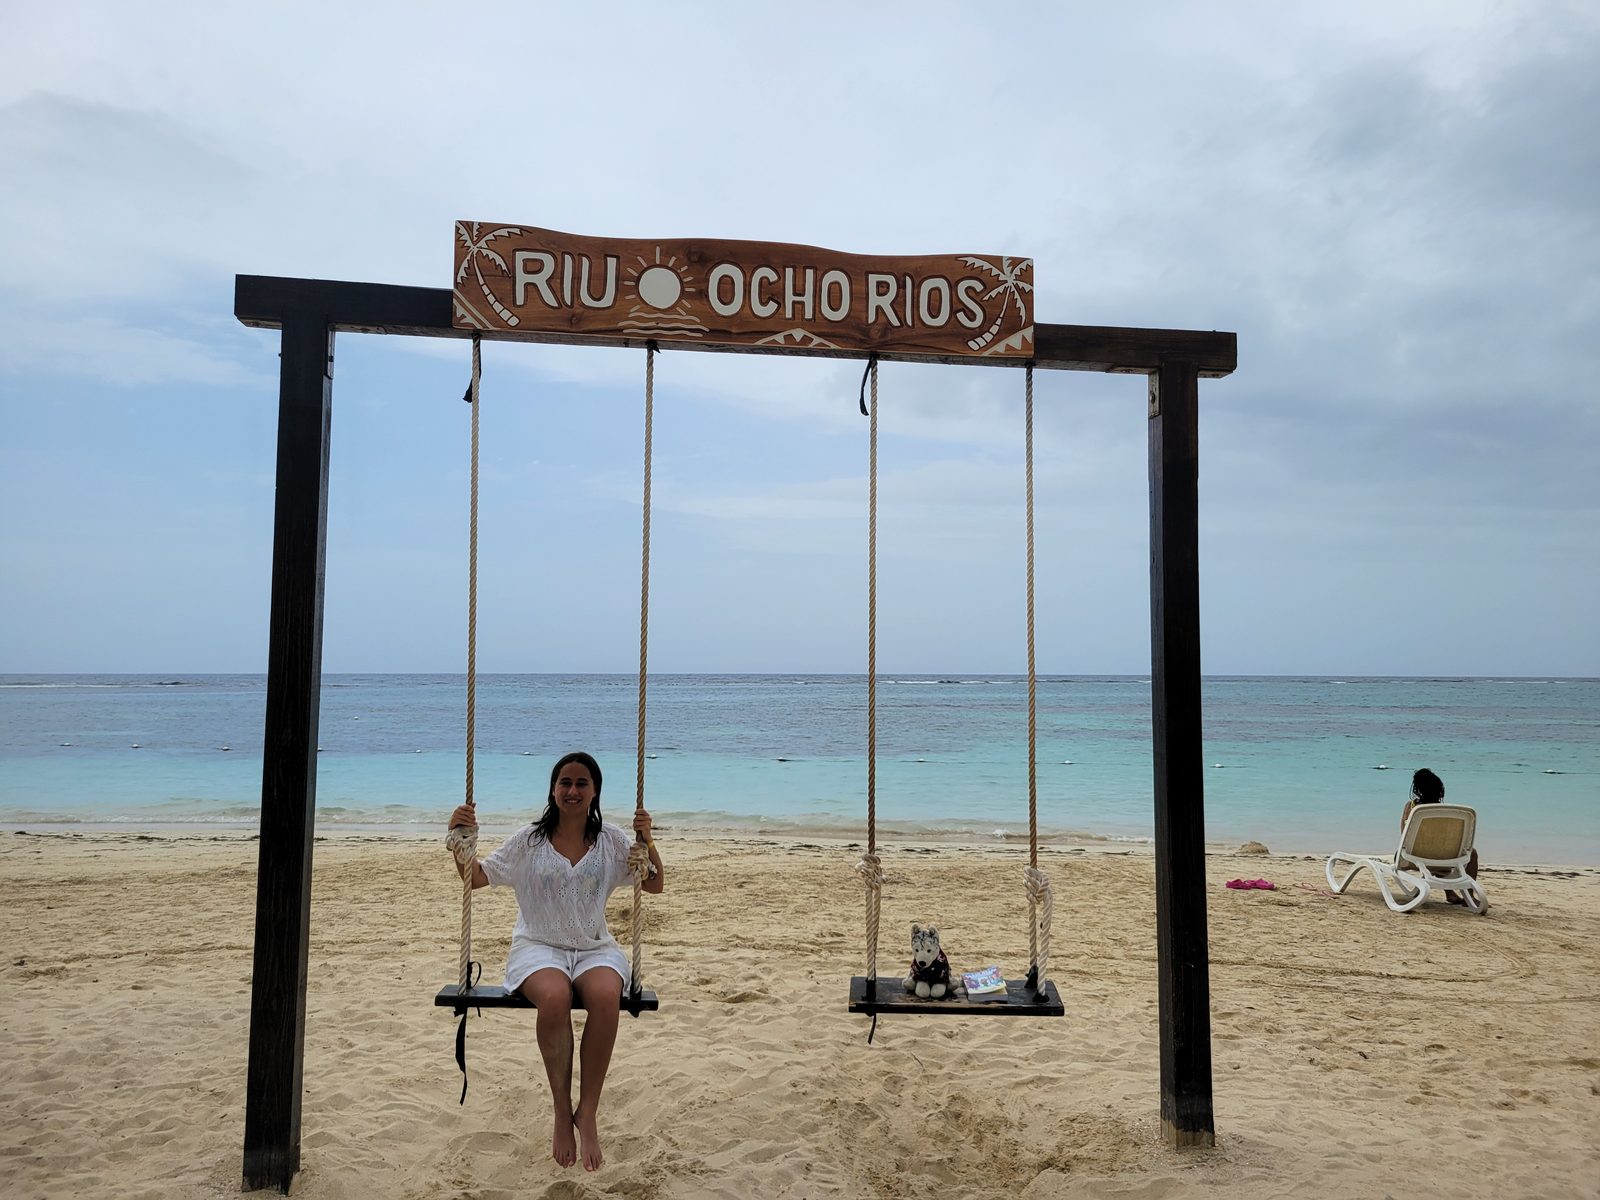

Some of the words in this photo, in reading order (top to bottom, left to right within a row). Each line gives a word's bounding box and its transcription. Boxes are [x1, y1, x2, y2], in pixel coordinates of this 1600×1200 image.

[514, 250, 618, 309] RIU
[708, 263, 850, 322] OCHO
[867, 273, 986, 329] RIOS
